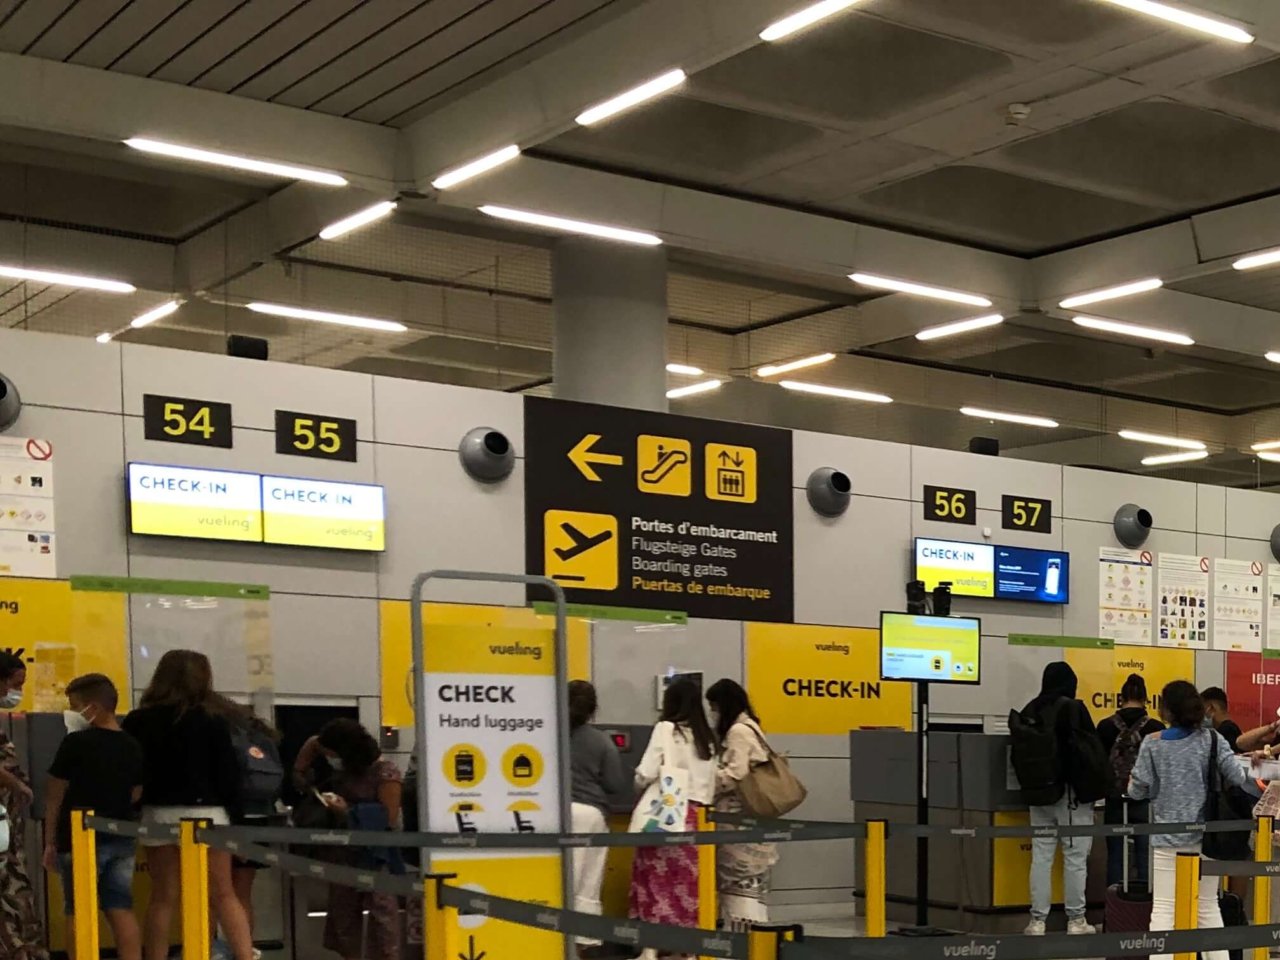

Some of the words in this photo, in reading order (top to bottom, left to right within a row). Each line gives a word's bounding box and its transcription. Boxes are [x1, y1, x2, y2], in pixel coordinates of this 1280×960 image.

[163, 402, 215, 439] 54
[293, 418, 341, 453] 55
[139, 475, 228, 495] CHECK-IN
[935, 491, 966, 518] 56
[1012, 502, 1042, 527] 57
[631, 516, 675, 534] Portes
[677, 521, 778, 543] d'embarcament
[631, 536, 698, 557] Flugsteige
[700, 542, 738, 558] Gates
[921, 547, 975, 562] CHECK-IN
[631, 556, 691, 576] Boarding
[693, 563, 728, 578] gates
[631, 576, 683, 593] Puertas
[687, 581, 703, 594] de
[707, 583, 771, 600] embarque
[489, 642, 542, 660] vueling
[815, 641, 850, 655] vueling
[1117, 659, 1144, 671] vueling
[438, 684, 516, 703] CHECK
[783, 678, 881, 699] CHECK-IN
[438, 713, 480, 729] Hand
[484, 714, 544, 732] luggage
[944, 939, 1000, 960] vueling
[1119, 932, 1169, 951] vueling
